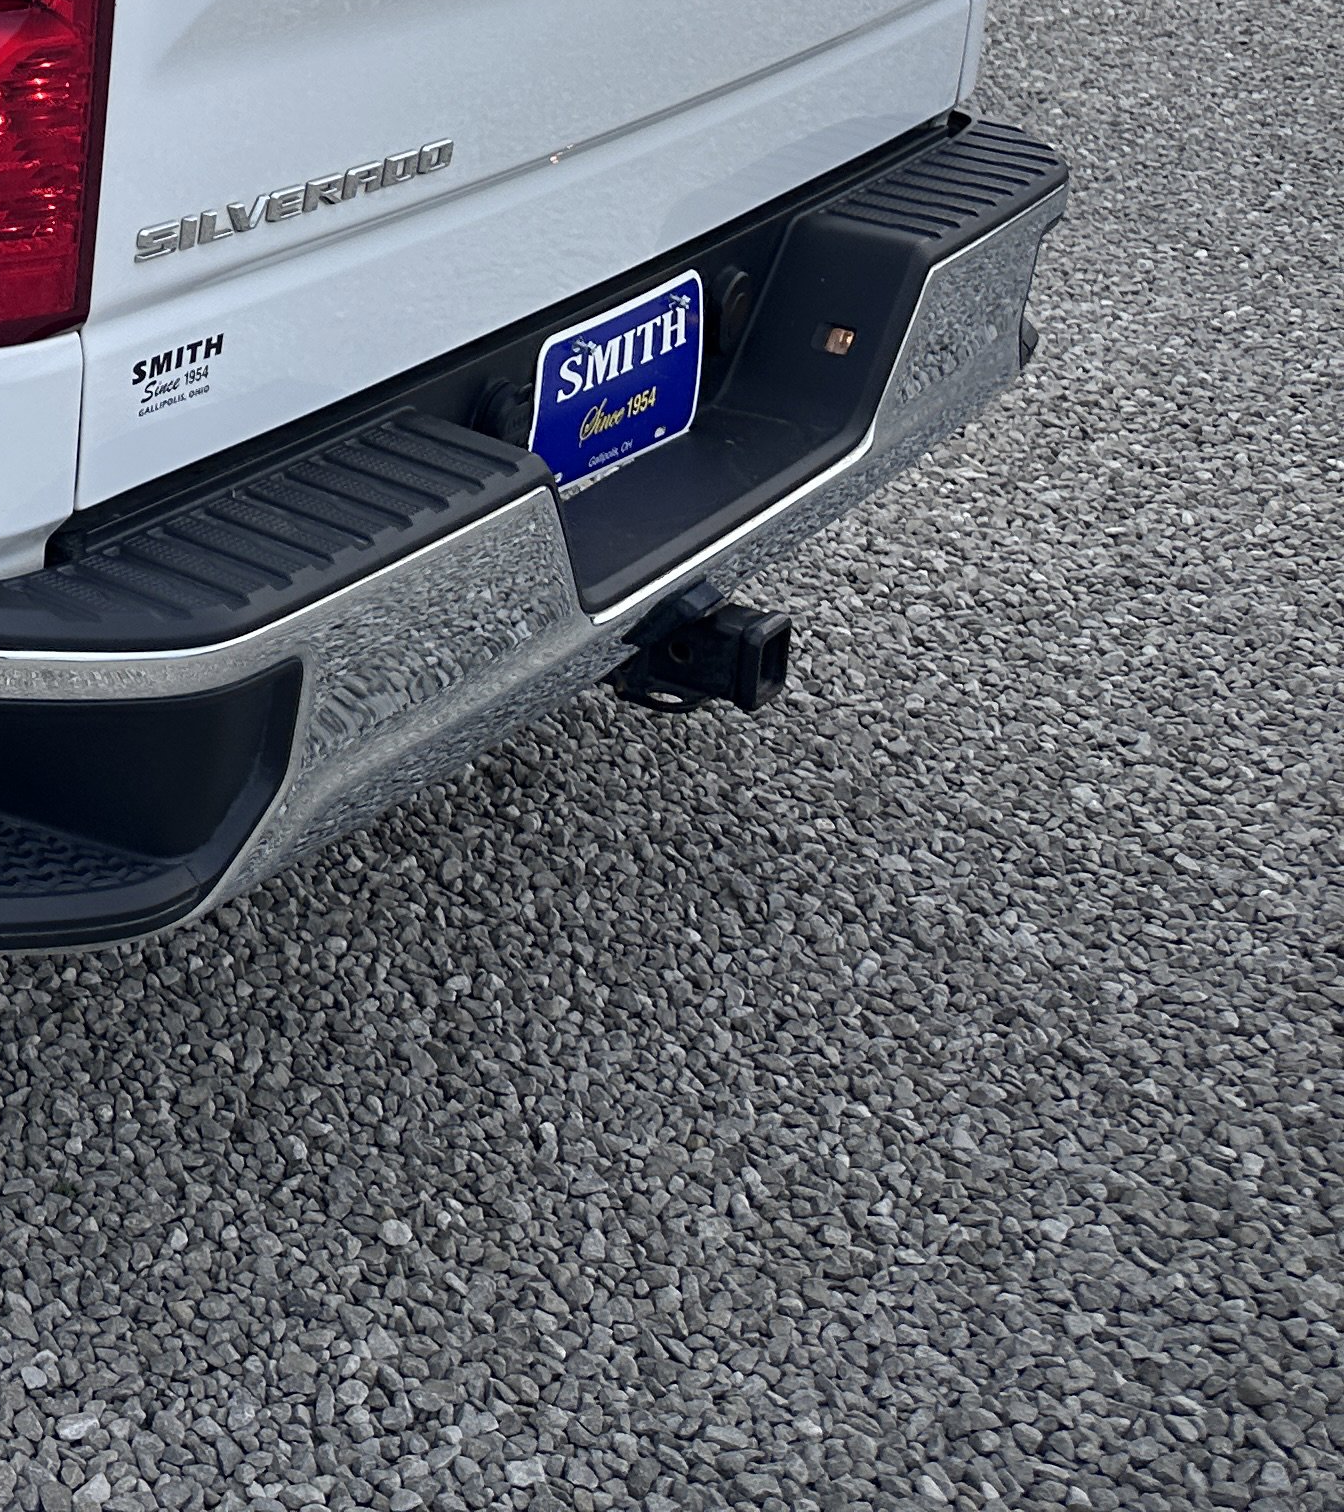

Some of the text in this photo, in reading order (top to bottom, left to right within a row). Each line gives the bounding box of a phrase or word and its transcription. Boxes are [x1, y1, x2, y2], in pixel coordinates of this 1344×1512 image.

[133, 137, 455, 264] SILVERADO
[132, 332, 225, 386] SMITH
[556, 306, 687, 404] SMITH
[140, 364, 209, 404] Since 1954
[188, 384, 210, 399] OHIO
[579, 385, 657, 448] Since 1954
[620, 439, 633, 455] OH
